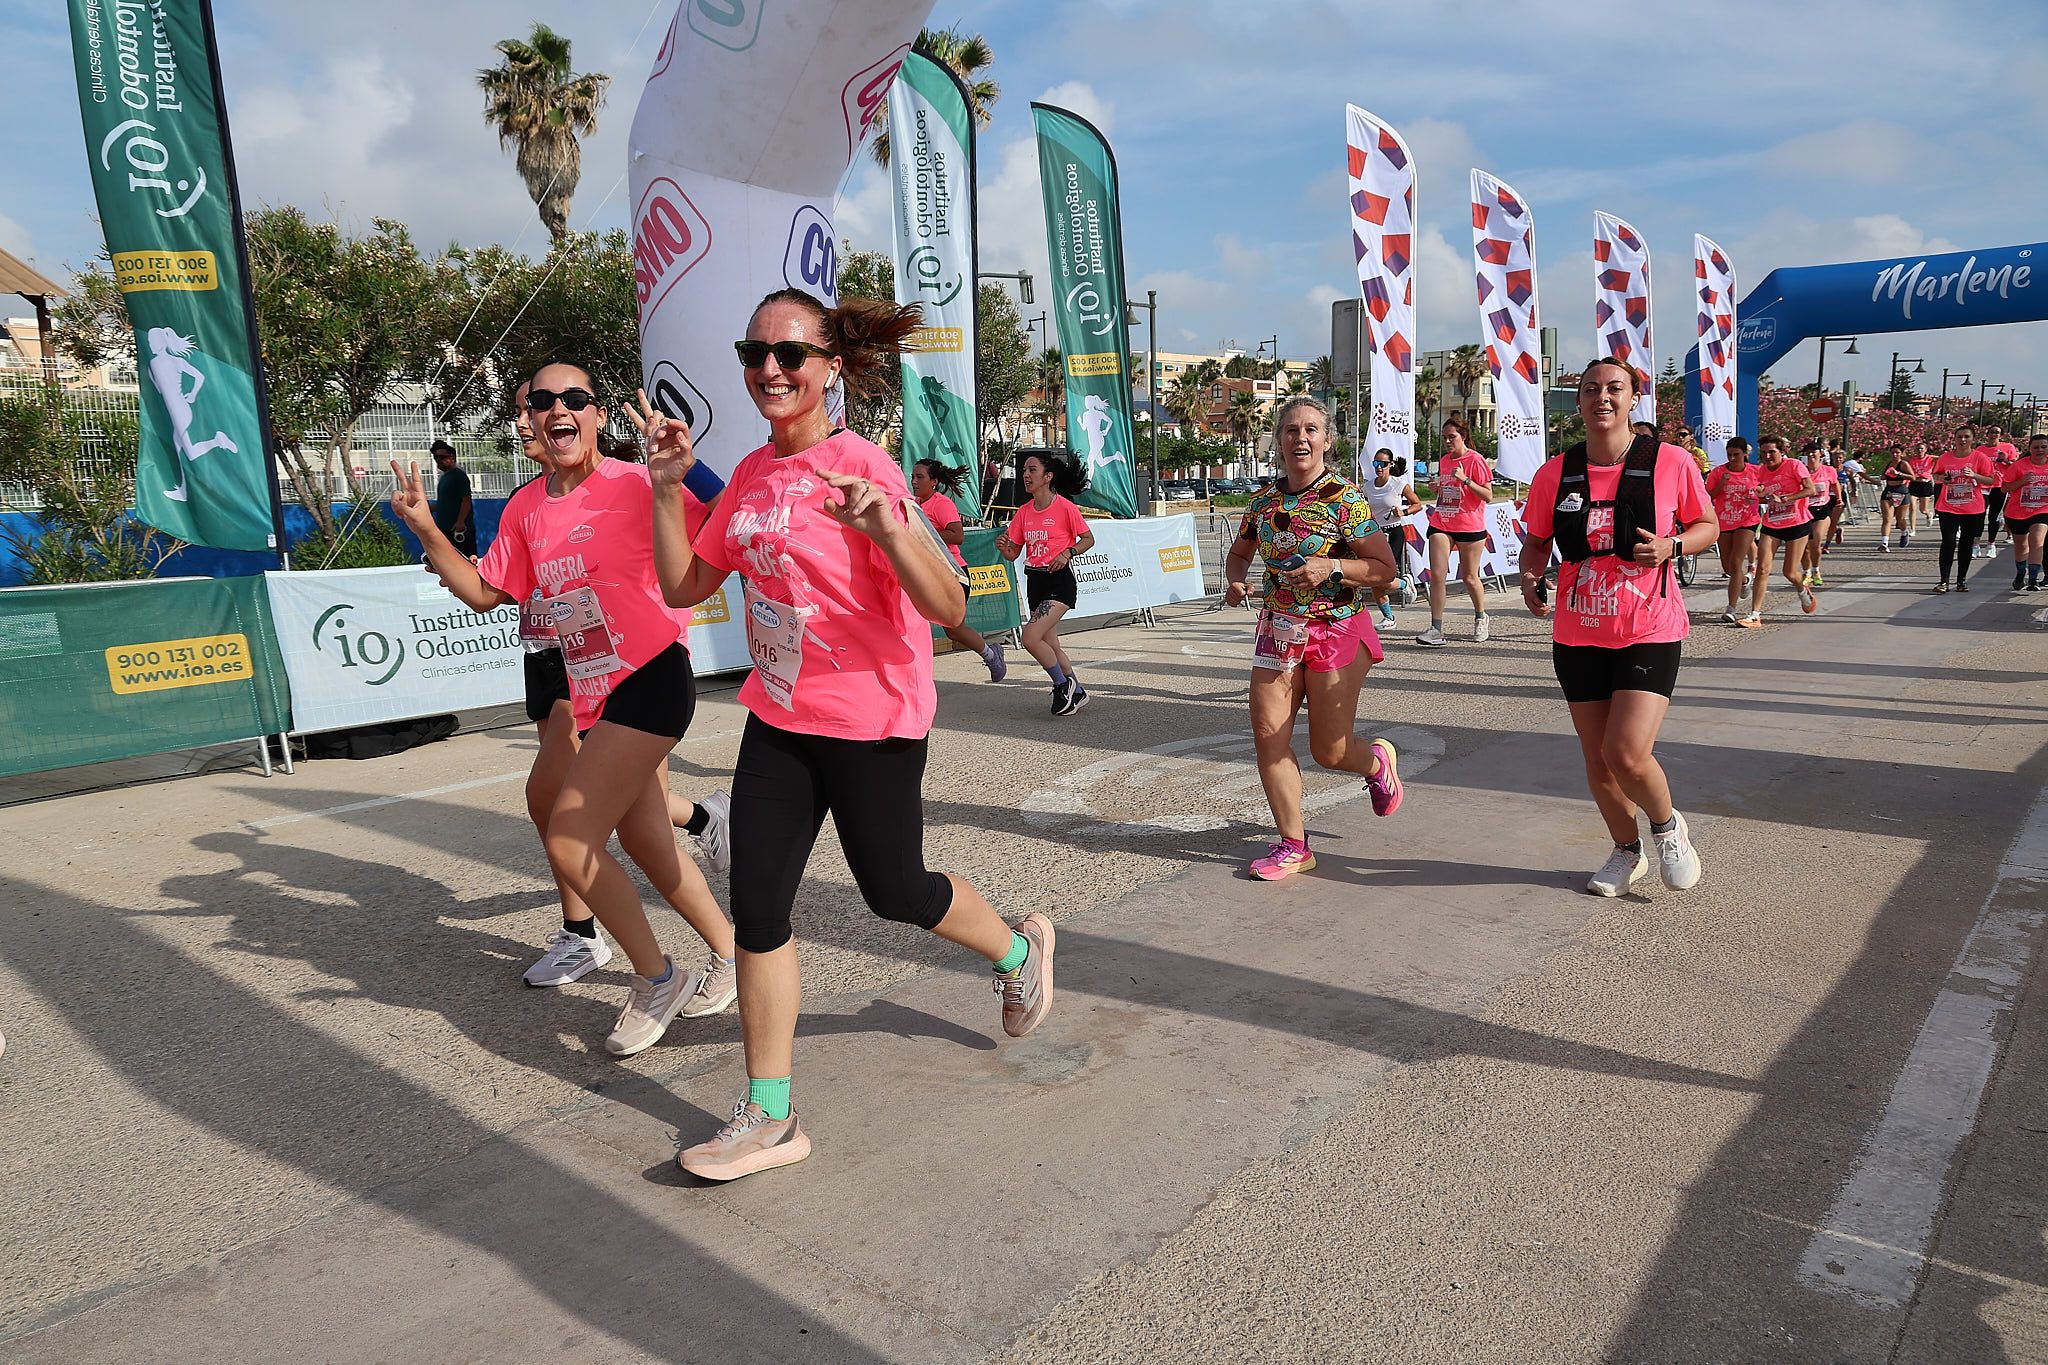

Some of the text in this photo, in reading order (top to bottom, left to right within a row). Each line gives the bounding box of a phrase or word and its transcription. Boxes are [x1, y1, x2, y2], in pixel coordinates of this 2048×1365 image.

[1871, 255, 2032, 320] Marlene
[535, 553, 587, 587] ARRERA
[1076, 566, 1133, 582] dontológicos
[408, 606, 520, 634] Institutos
[531, 614, 554, 627] 016
[1580, 616, 1600, 628] 2026
[117, 642, 241, 669] 900 131 002
[415, 626, 521, 660] Odontoló
[754, 638, 778, 663] 016
[121, 660, 244, 685] www.ioa.es
[421, 657, 517, 680] Clínicas dentales
